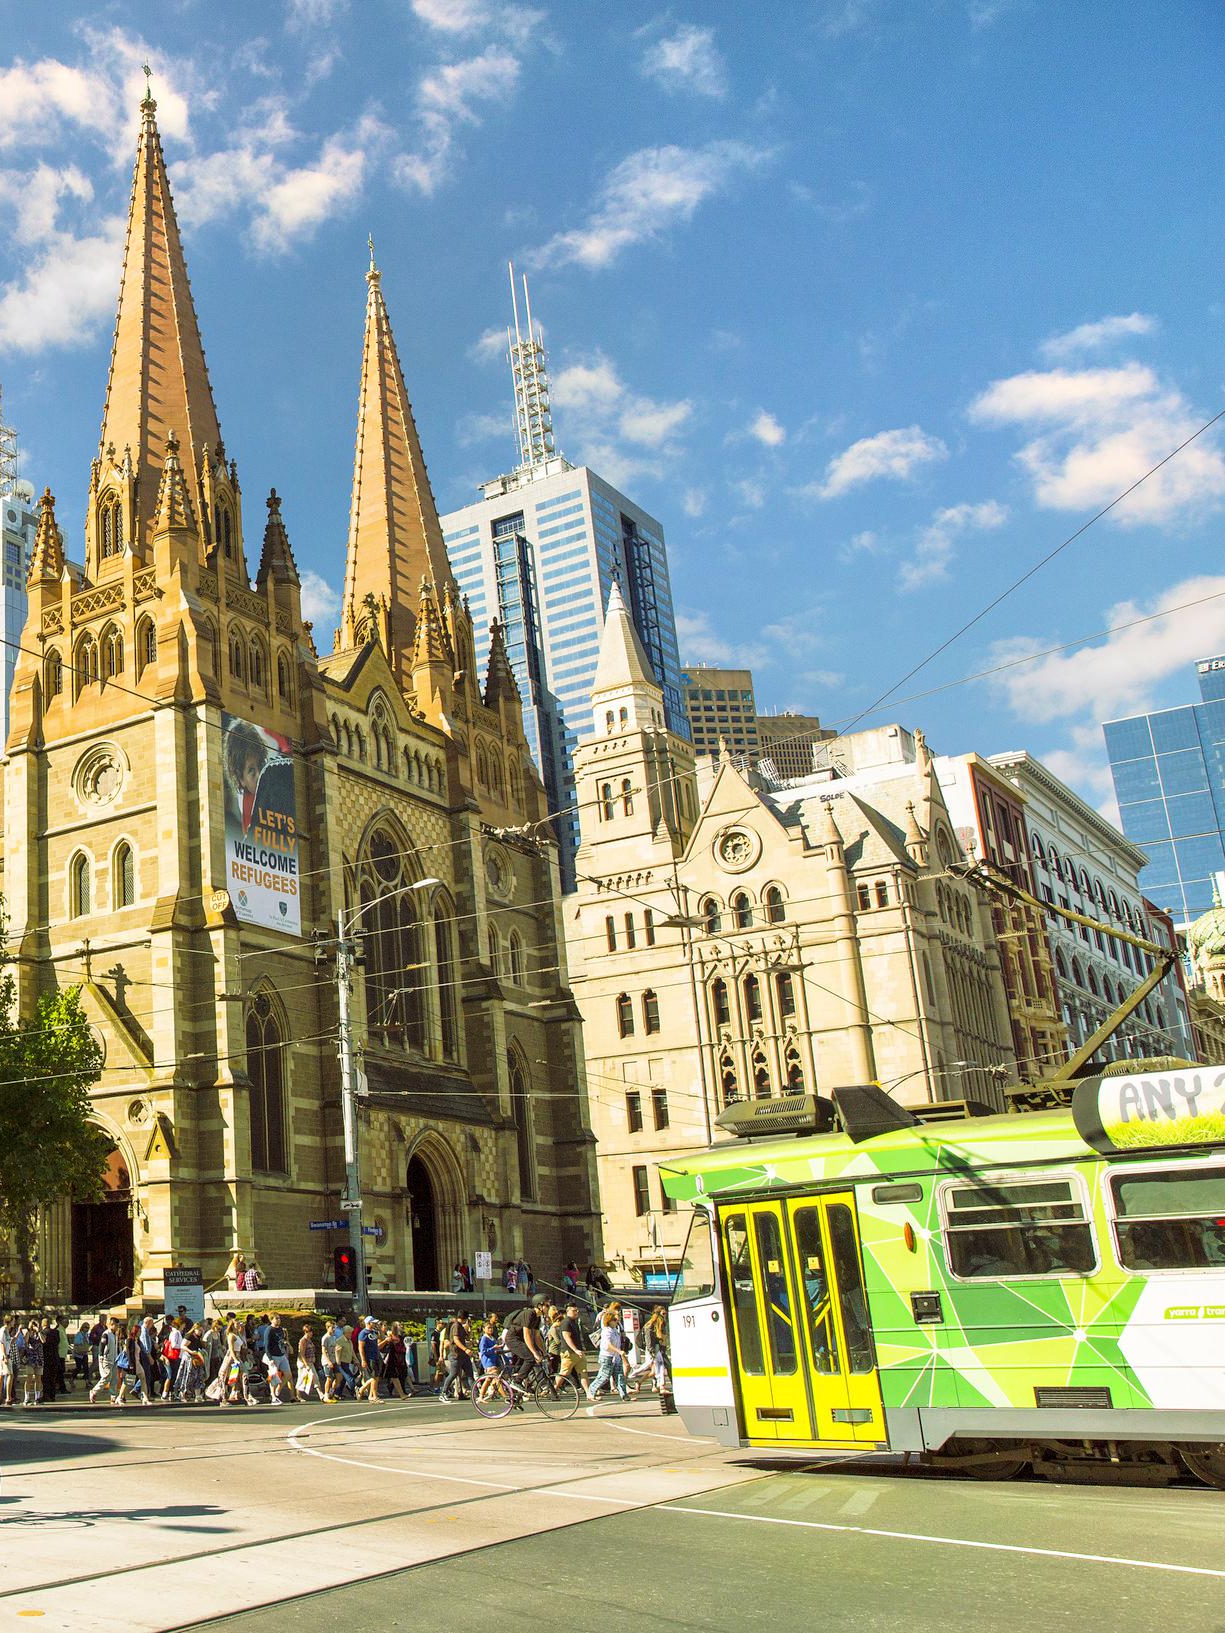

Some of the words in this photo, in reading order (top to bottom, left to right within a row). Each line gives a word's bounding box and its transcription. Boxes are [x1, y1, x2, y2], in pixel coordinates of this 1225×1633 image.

[258, 807, 295, 833] LET'S
[254, 826, 296, 856] FULLY
[234, 840, 296, 875] WELCOME
[231, 860, 297, 896] REFUGEES
[212, 901, 227, 911] OFF
[1119, 1074, 1202, 1123] ANY
[682, 1315, 695, 1327] 191
[1168, 1309, 1196, 1318] yarra
